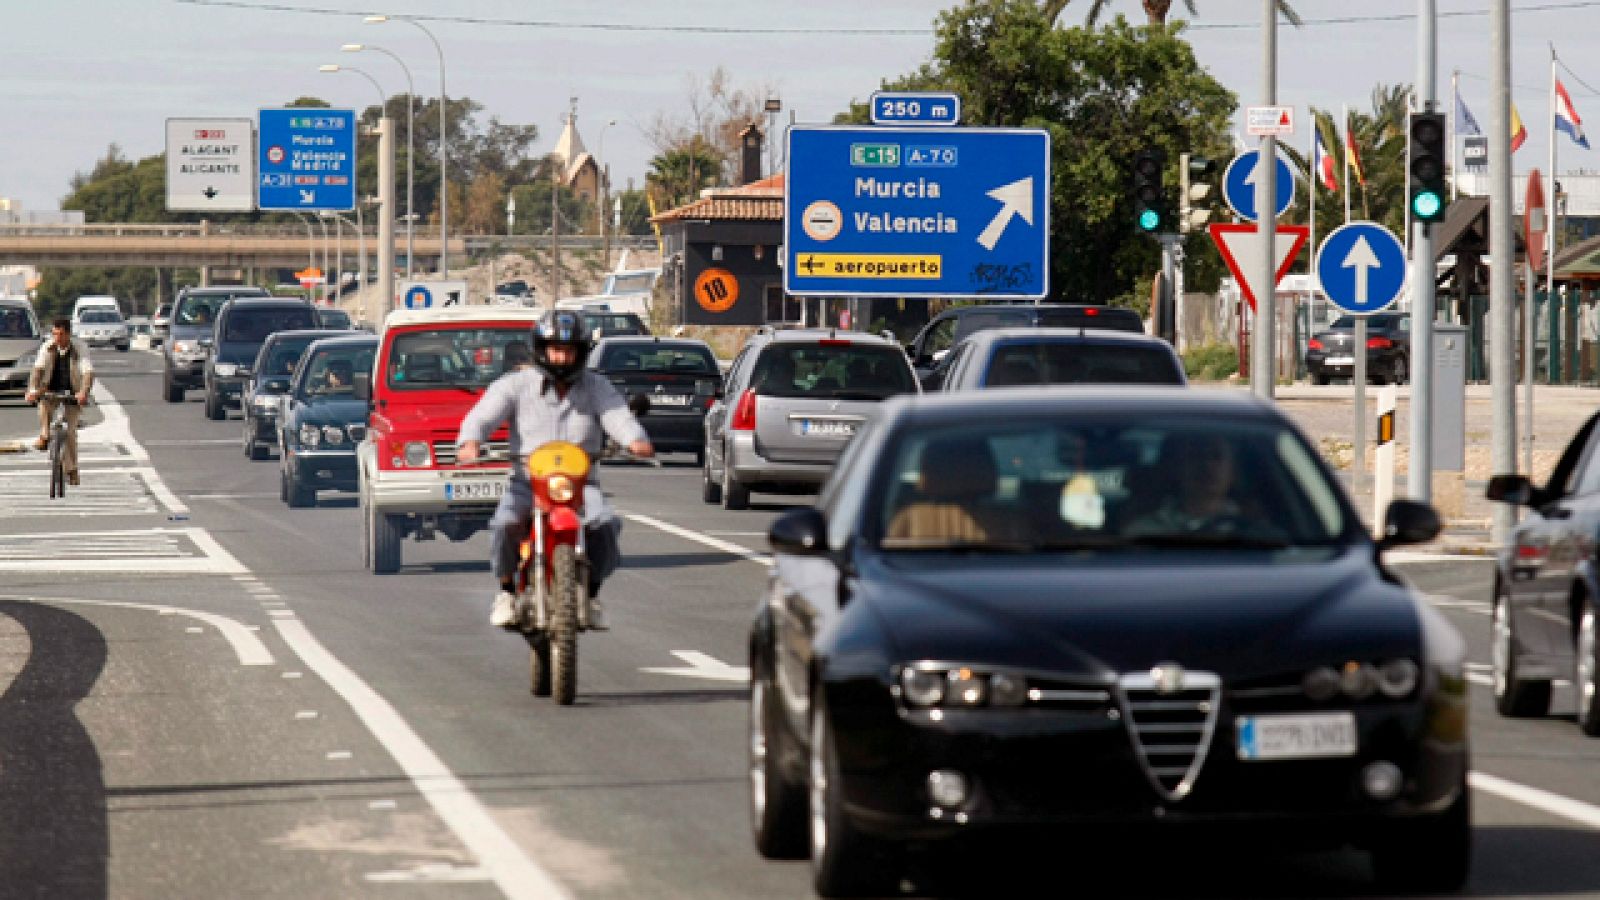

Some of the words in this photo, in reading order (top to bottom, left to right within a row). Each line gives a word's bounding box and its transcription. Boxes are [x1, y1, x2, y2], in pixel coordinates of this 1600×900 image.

[881, 101, 920, 118] 250
[931, 104, 948, 118] m
[854, 147, 899, 163] E-15
[908, 148, 956, 164] A-70
[291, 160, 340, 171] Madrid
[854, 177, 940, 199] Murcia
[854, 211, 958, 234] Valencia
[834, 258, 939, 276] aeropuerto
[703, 277, 729, 303] 10
